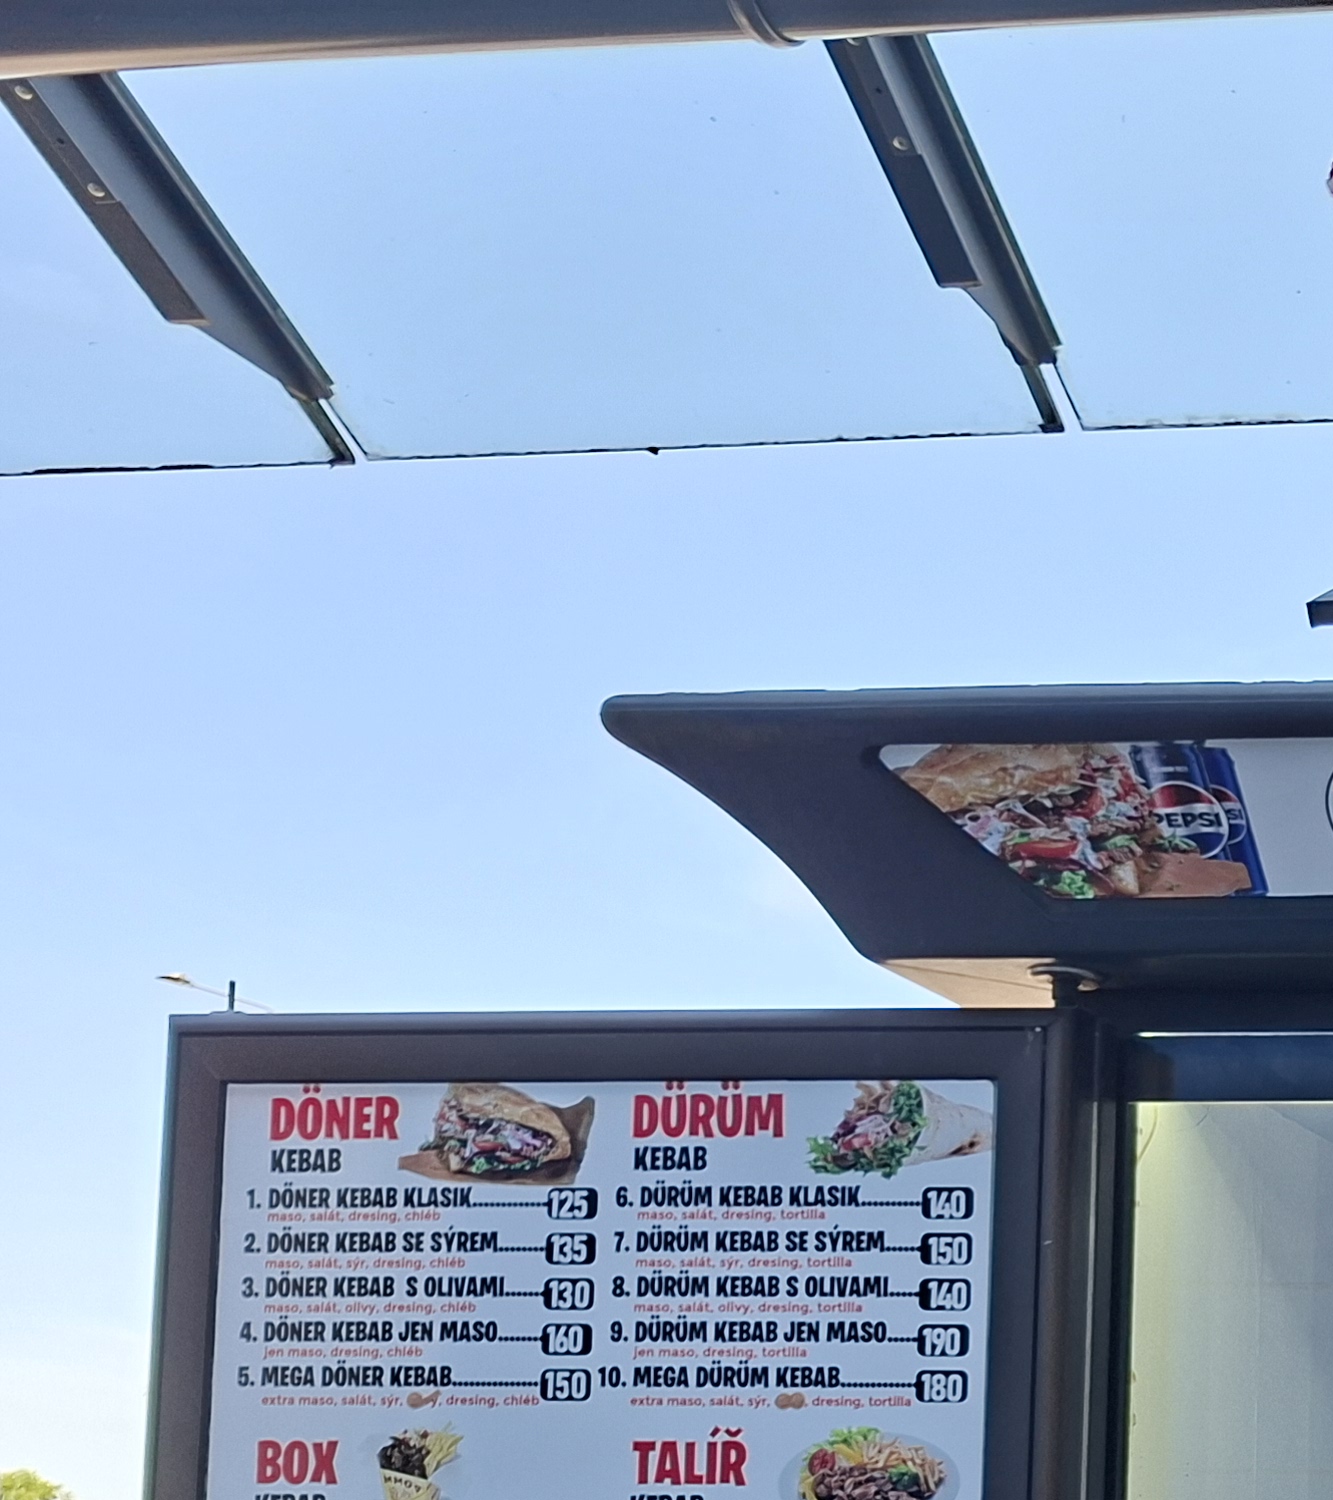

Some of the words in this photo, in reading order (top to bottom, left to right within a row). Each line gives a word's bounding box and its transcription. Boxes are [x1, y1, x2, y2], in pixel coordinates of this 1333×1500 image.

[269, 1085, 399, 1141] DÖNER
[632, 1080, 784, 1139] DÜRÜM
[270, 1149, 341, 1172] KEBAB
[633, 1146, 707, 1170] KEBAB
[246, 1190, 261, 1209] 1.
[268, 1182, 332, 1209] DÖNER
[337, 1188, 397, 1208] KEBAB
[549, 1190, 588, 1219] 125
[615, 1186, 632, 1208] 6.
[640, 1181, 712, 1208] DÜRÜM
[719, 1185, 782, 1207] KEBAB
[926, 1190, 966, 1218] 140
[241, 1277, 259, 1298] 3.
[265, 1272, 327, 1298] DÖNER
[333, 1277, 394, 1297] KEBAB
[406, 1277, 418, 1297] S
[548, 1281, 589, 1309] 130
[599, 1367, 627, 1387] 10.
[632, 1367, 688, 1387] MEGA
[696, 1361, 768, 1387] DÜRÜM
[921, 1374, 963, 1401] 180
[257, 1440, 338, 1484] BOX
[632, 1427, 747, 1485] TALÍŘ
